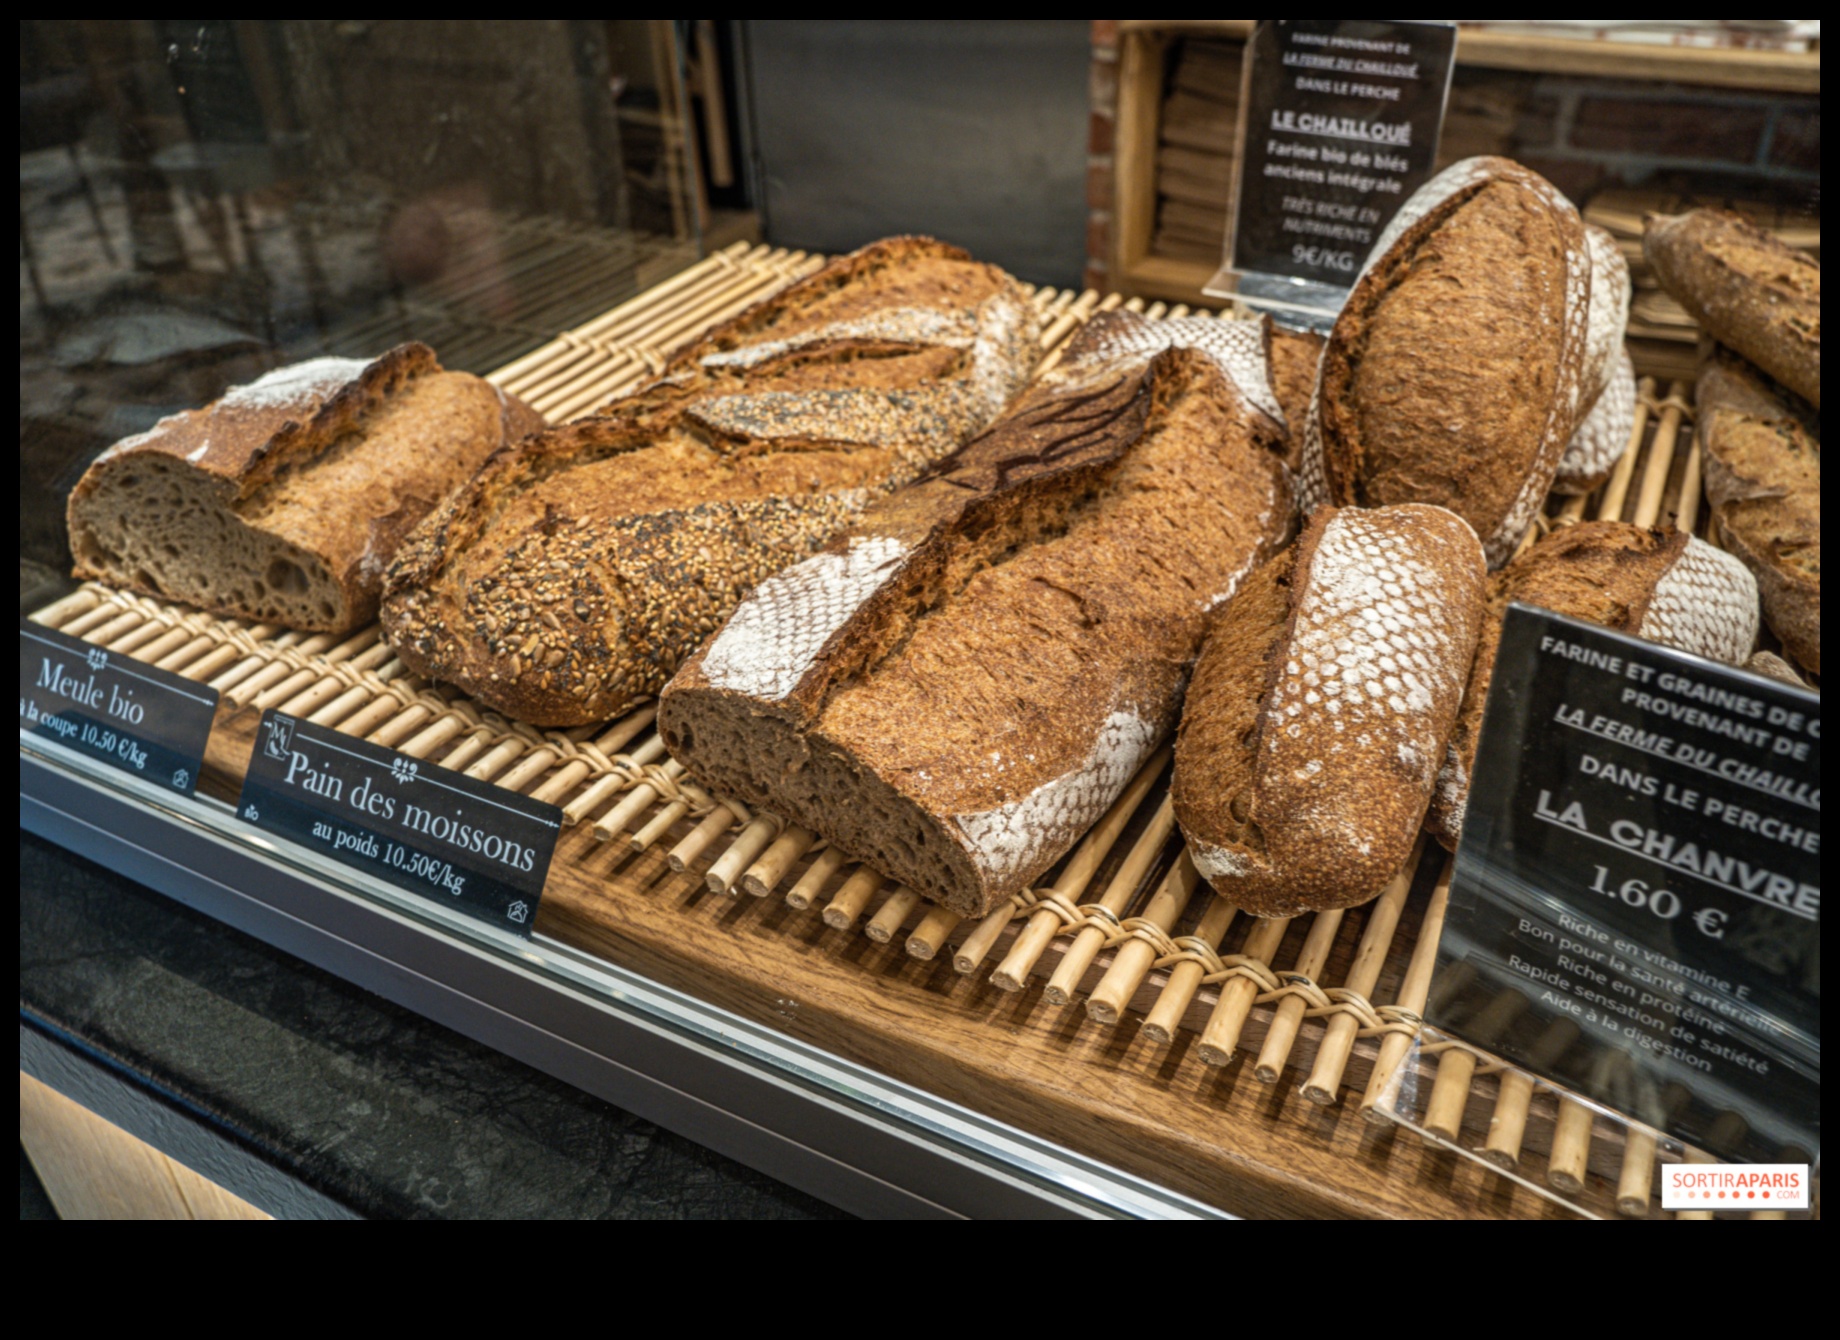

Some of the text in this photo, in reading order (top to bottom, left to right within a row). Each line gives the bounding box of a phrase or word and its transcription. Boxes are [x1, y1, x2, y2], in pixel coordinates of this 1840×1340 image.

[1295, 76, 1400, 100] DANS LE PERCHE
[1267, 139, 1318, 160] Farine
[1321, 146, 1347, 164] bio
[1350, 151, 1371, 168] de
[1271, 109, 1412, 144] LE CHAILLOUÉ
[1263, 163, 1402, 194] anciens intégrale
[1292, 243, 1354, 272] 9€/KG
[36, 657, 144, 725] Meule bio
[1540, 635, 1621, 675] FARINE
[1626, 661, 1655, 685] ET
[1657, 672, 1765, 719] GRAINES
[1767, 705, 1805, 733] DE
[27, 700, 40, 721] la
[40, 712, 78, 737] coupe
[81, 723, 117, 752] 10.50
[118, 738, 148, 769] €/kg
[1555, 703, 1585, 727] LA
[1590, 714, 1673, 757] FERME
[1675, 742, 1716, 770] DU
[1621, 687, 1810, 762] PROVENANT DE
[284, 749, 536, 873] Pain des moissons
[1580, 754, 1820, 854] DANS LE PERCHE
[312, 820, 466, 896] au poids 10.50€/kg
[1535, 789, 1820, 914] LA CHANVRE
[1588, 864, 1729, 939] 1.60 €
[1518, 918, 1554, 943] Bon
[1558, 937, 1606, 961] pour
[1609, 955, 1625, 972] la
[1630, 966, 1685, 995] santé
[1558, 913, 1751, 1000] Riche en vitamine E
[1509, 954, 1769, 1075] Rapide sensation de satiété
[1541, 991, 1712, 1072] Aide à la digestion
[1557, 954, 1726, 1035] Riche en protéine
